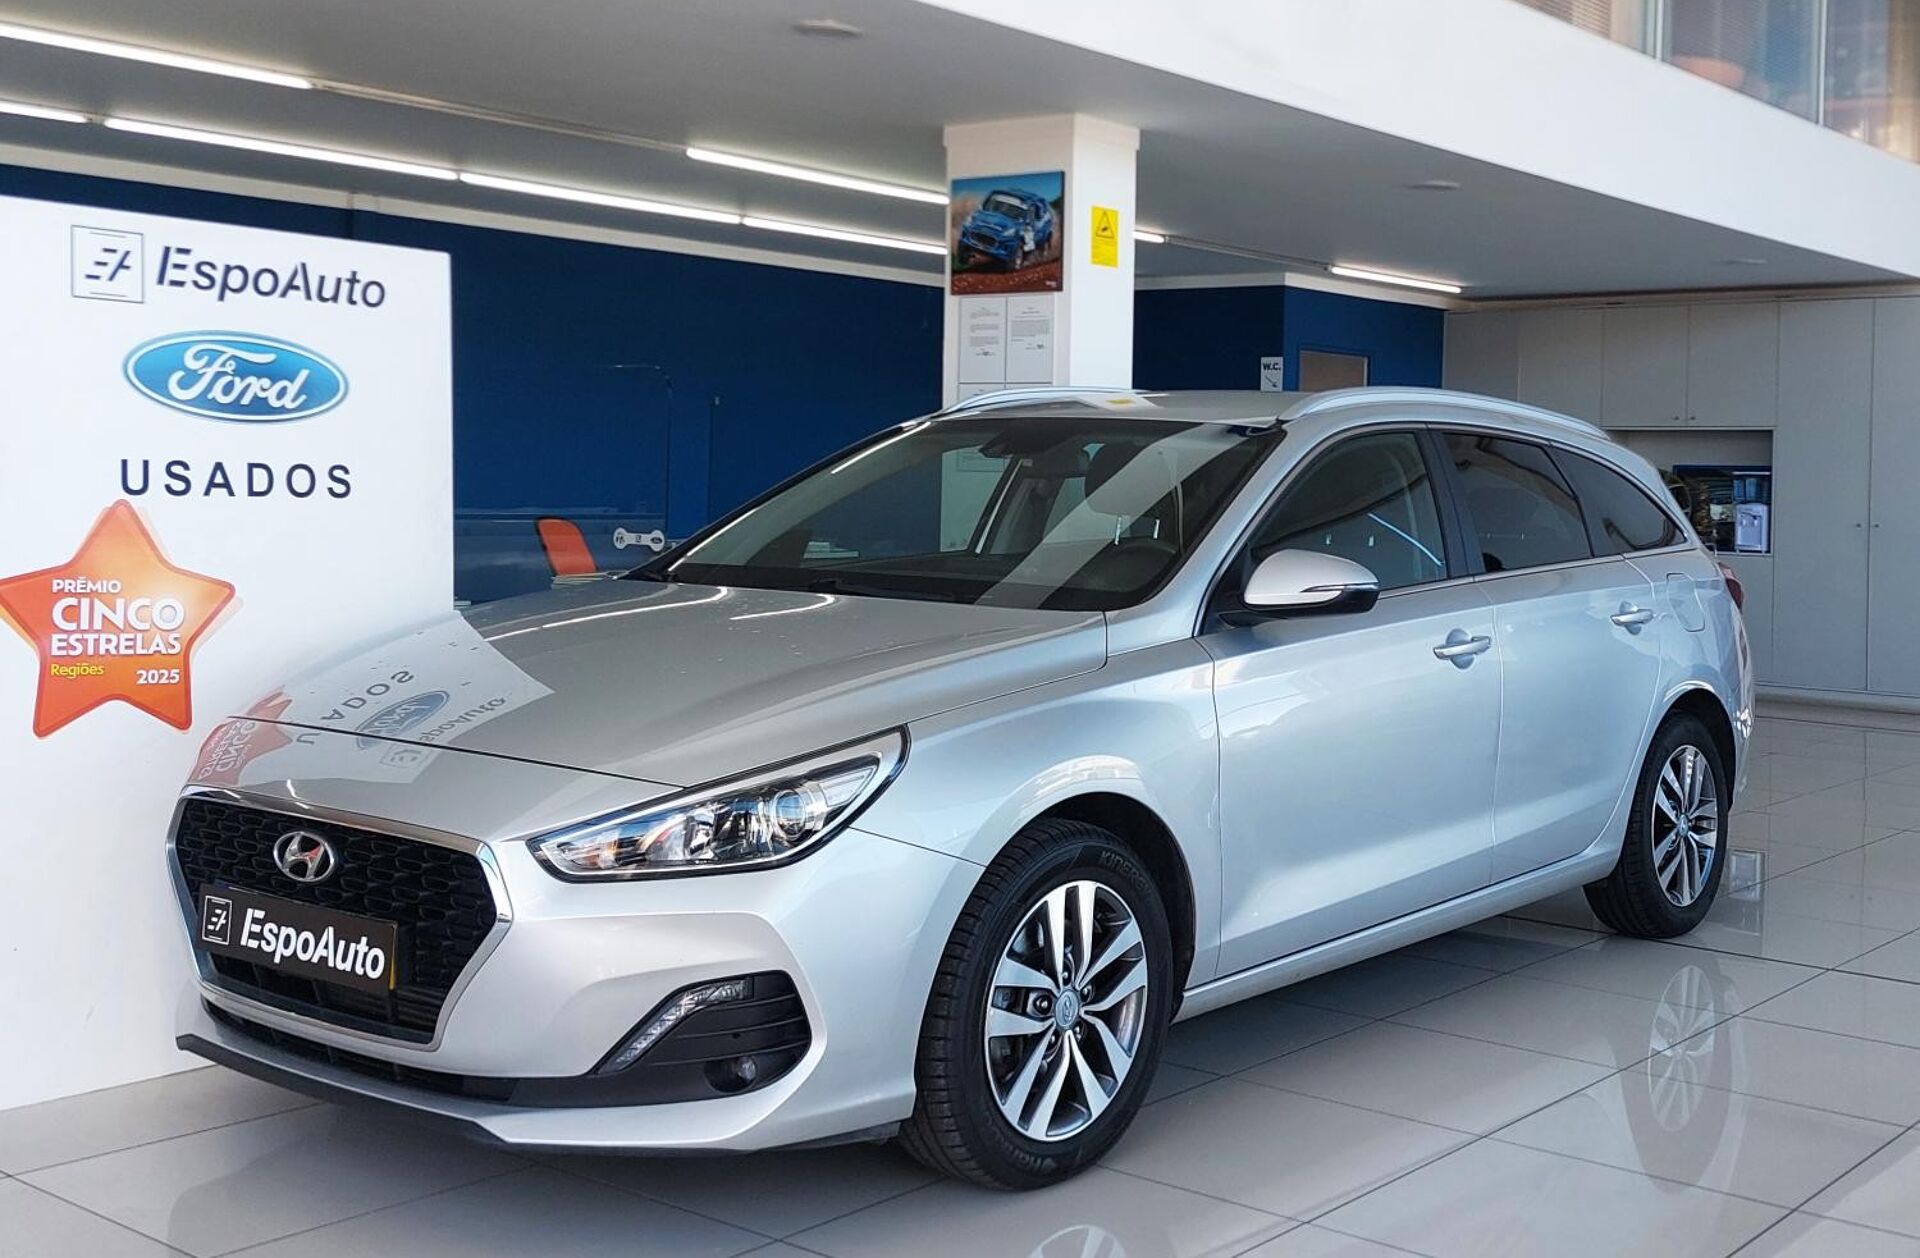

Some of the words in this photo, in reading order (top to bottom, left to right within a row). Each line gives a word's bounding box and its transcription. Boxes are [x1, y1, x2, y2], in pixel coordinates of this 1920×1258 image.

[156, 245, 387, 308] EspoAuto
[167, 342, 311, 410] Ford
[1262, 362, 1282, 372] W.C.
[119, 458, 353, 499] USADOS
[51, 597, 185, 632] CINCO
[50, 632, 182, 657] ESTRELAS
[50, 662, 105, 679] Regiões
[136, 668, 180, 685] 2025
[240, 907, 385, 980] EspoAuto
